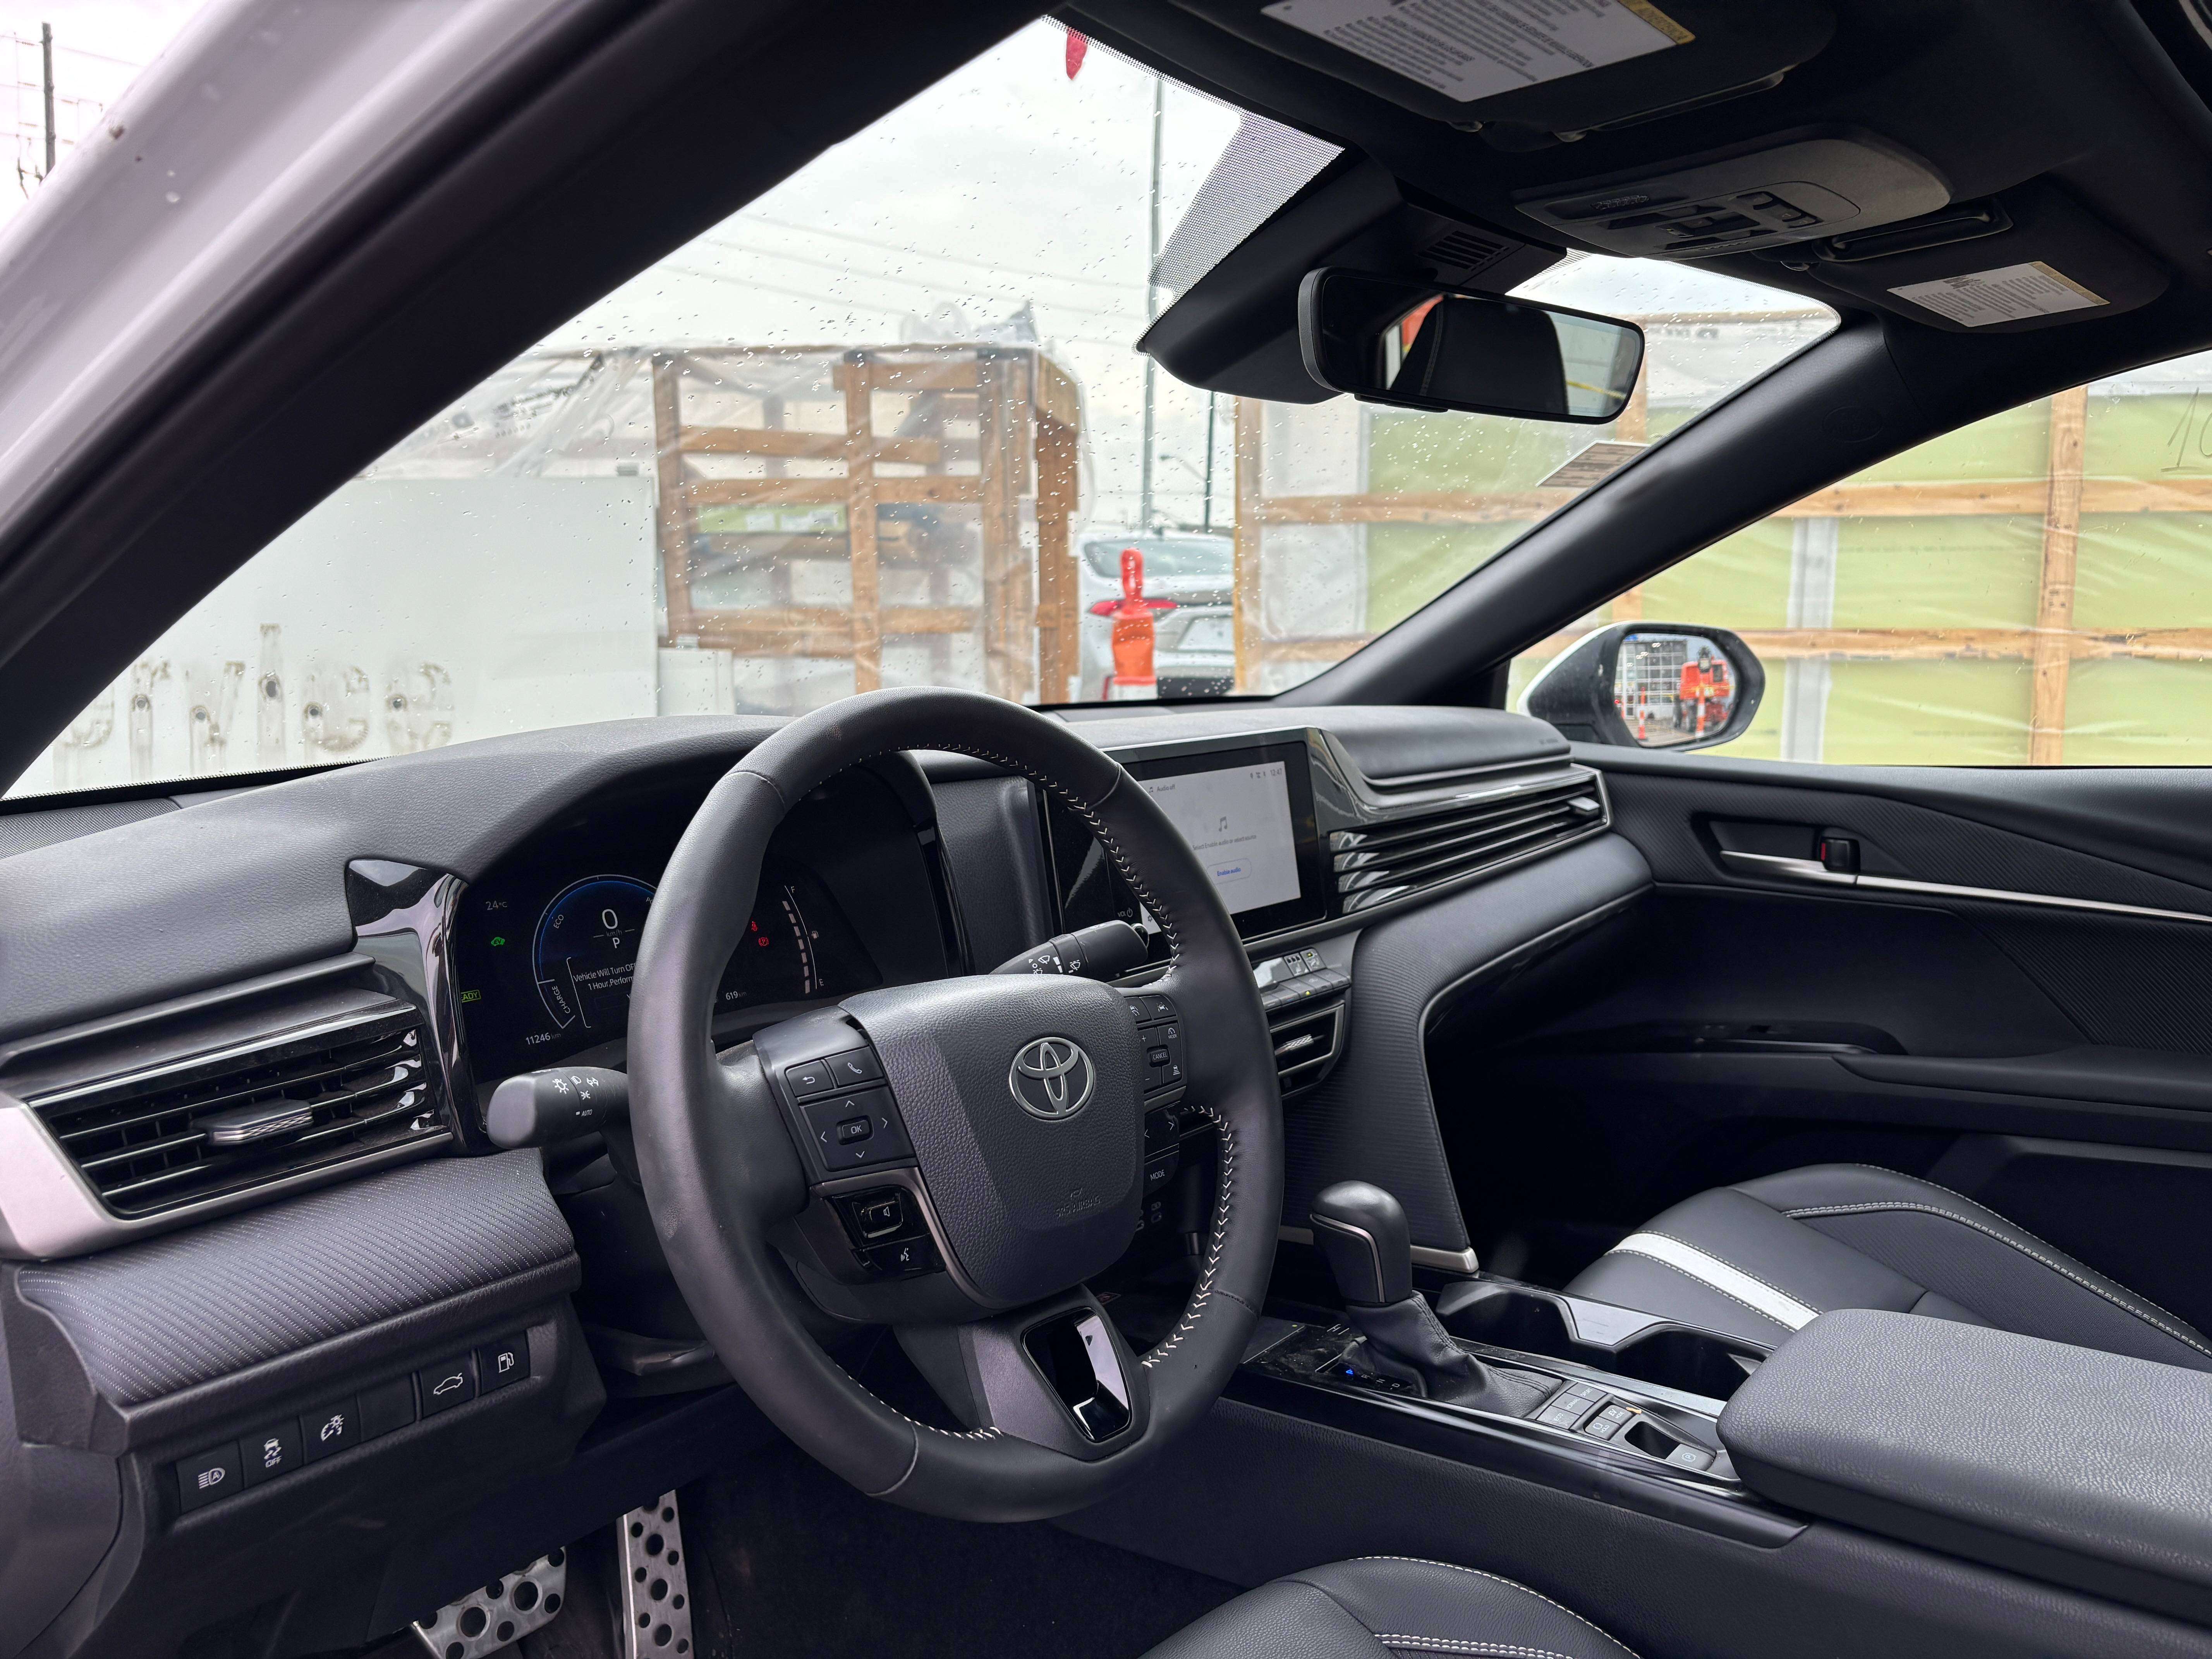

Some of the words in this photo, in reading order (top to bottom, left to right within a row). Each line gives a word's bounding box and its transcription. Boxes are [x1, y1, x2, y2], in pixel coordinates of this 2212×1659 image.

[553, 914, 564, 929] ECO
[602, 908, 618, 929] 0
[606, 929, 622, 937] km/h
[612, 937, 620, 948] P
[573, 971, 597, 982] Vehicle
[597, 969, 611, 977] Will
[610, 966, 625, 975] Turn
[819, 979, 824, 987] E
[461, 991, 478, 1001] ADY
[552, 985, 571, 1014] CHARGE
[725, 991, 738, 1001] 619
[526, 1032, 551, 1045] 11246
[581, 1109, 593, 1117] AUTO
[851, 1124, 862, 1134] OK
[1150, 1169, 1166, 1180] MODE
[1580, 1388, 1594, 1397] SPORT
[1565, 1398, 1581, 1410] NORMAL
[1553, 1412, 1564, 1422] ECO
[1608, 1408, 1617, 1417] EV
[1600, 1425, 1610, 1433] HOLD
[265, 1455, 282, 1468] OFF
